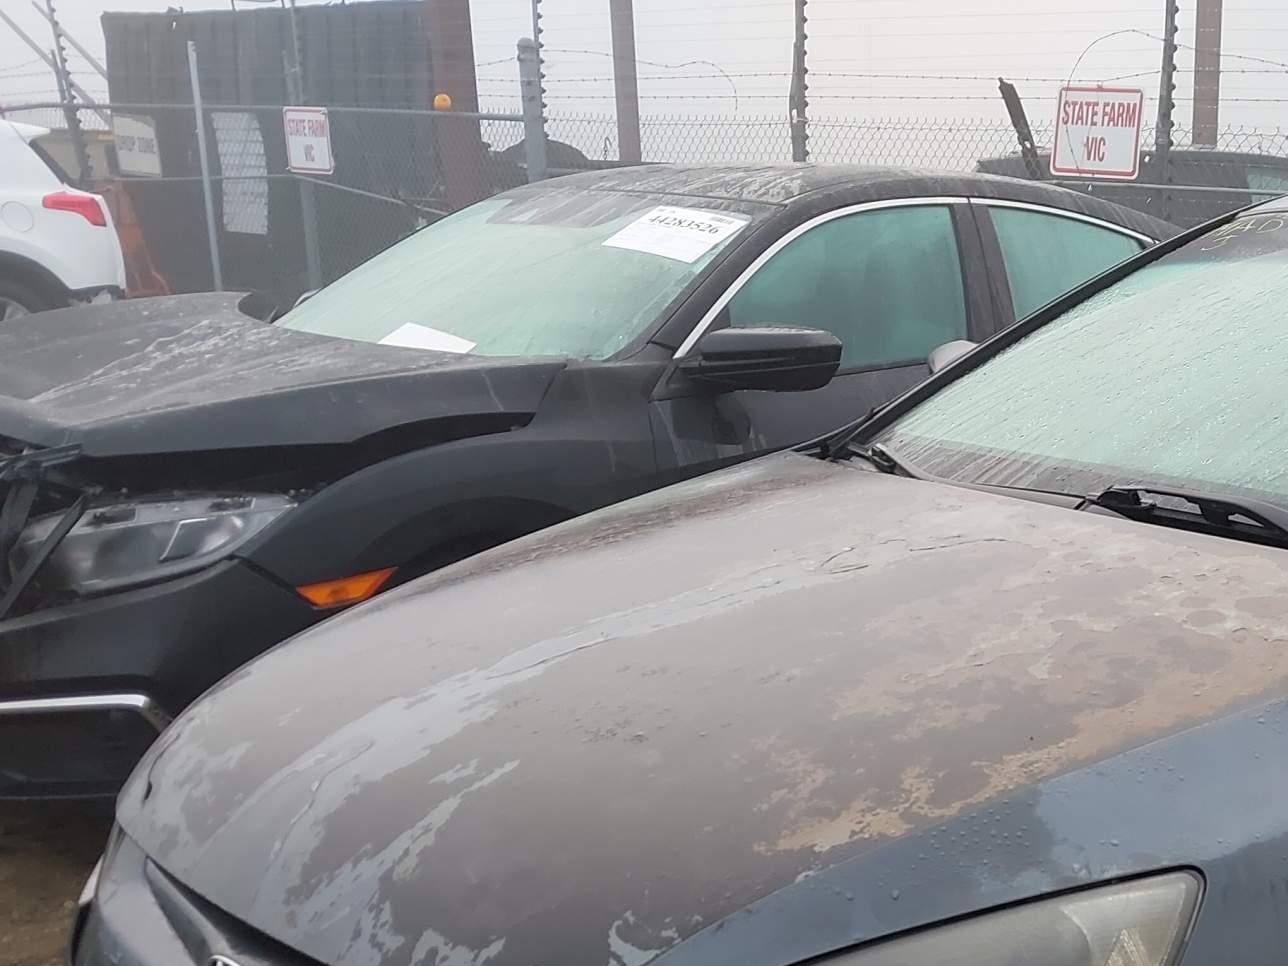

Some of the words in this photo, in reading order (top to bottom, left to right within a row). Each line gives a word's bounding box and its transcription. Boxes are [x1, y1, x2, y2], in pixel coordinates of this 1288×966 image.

[1062, 100, 1099, 126] STATE
[1101, 101, 1137, 128] FARM
[288, 119, 306, 137] STATE
[1086, 136, 1106, 162] VIC
